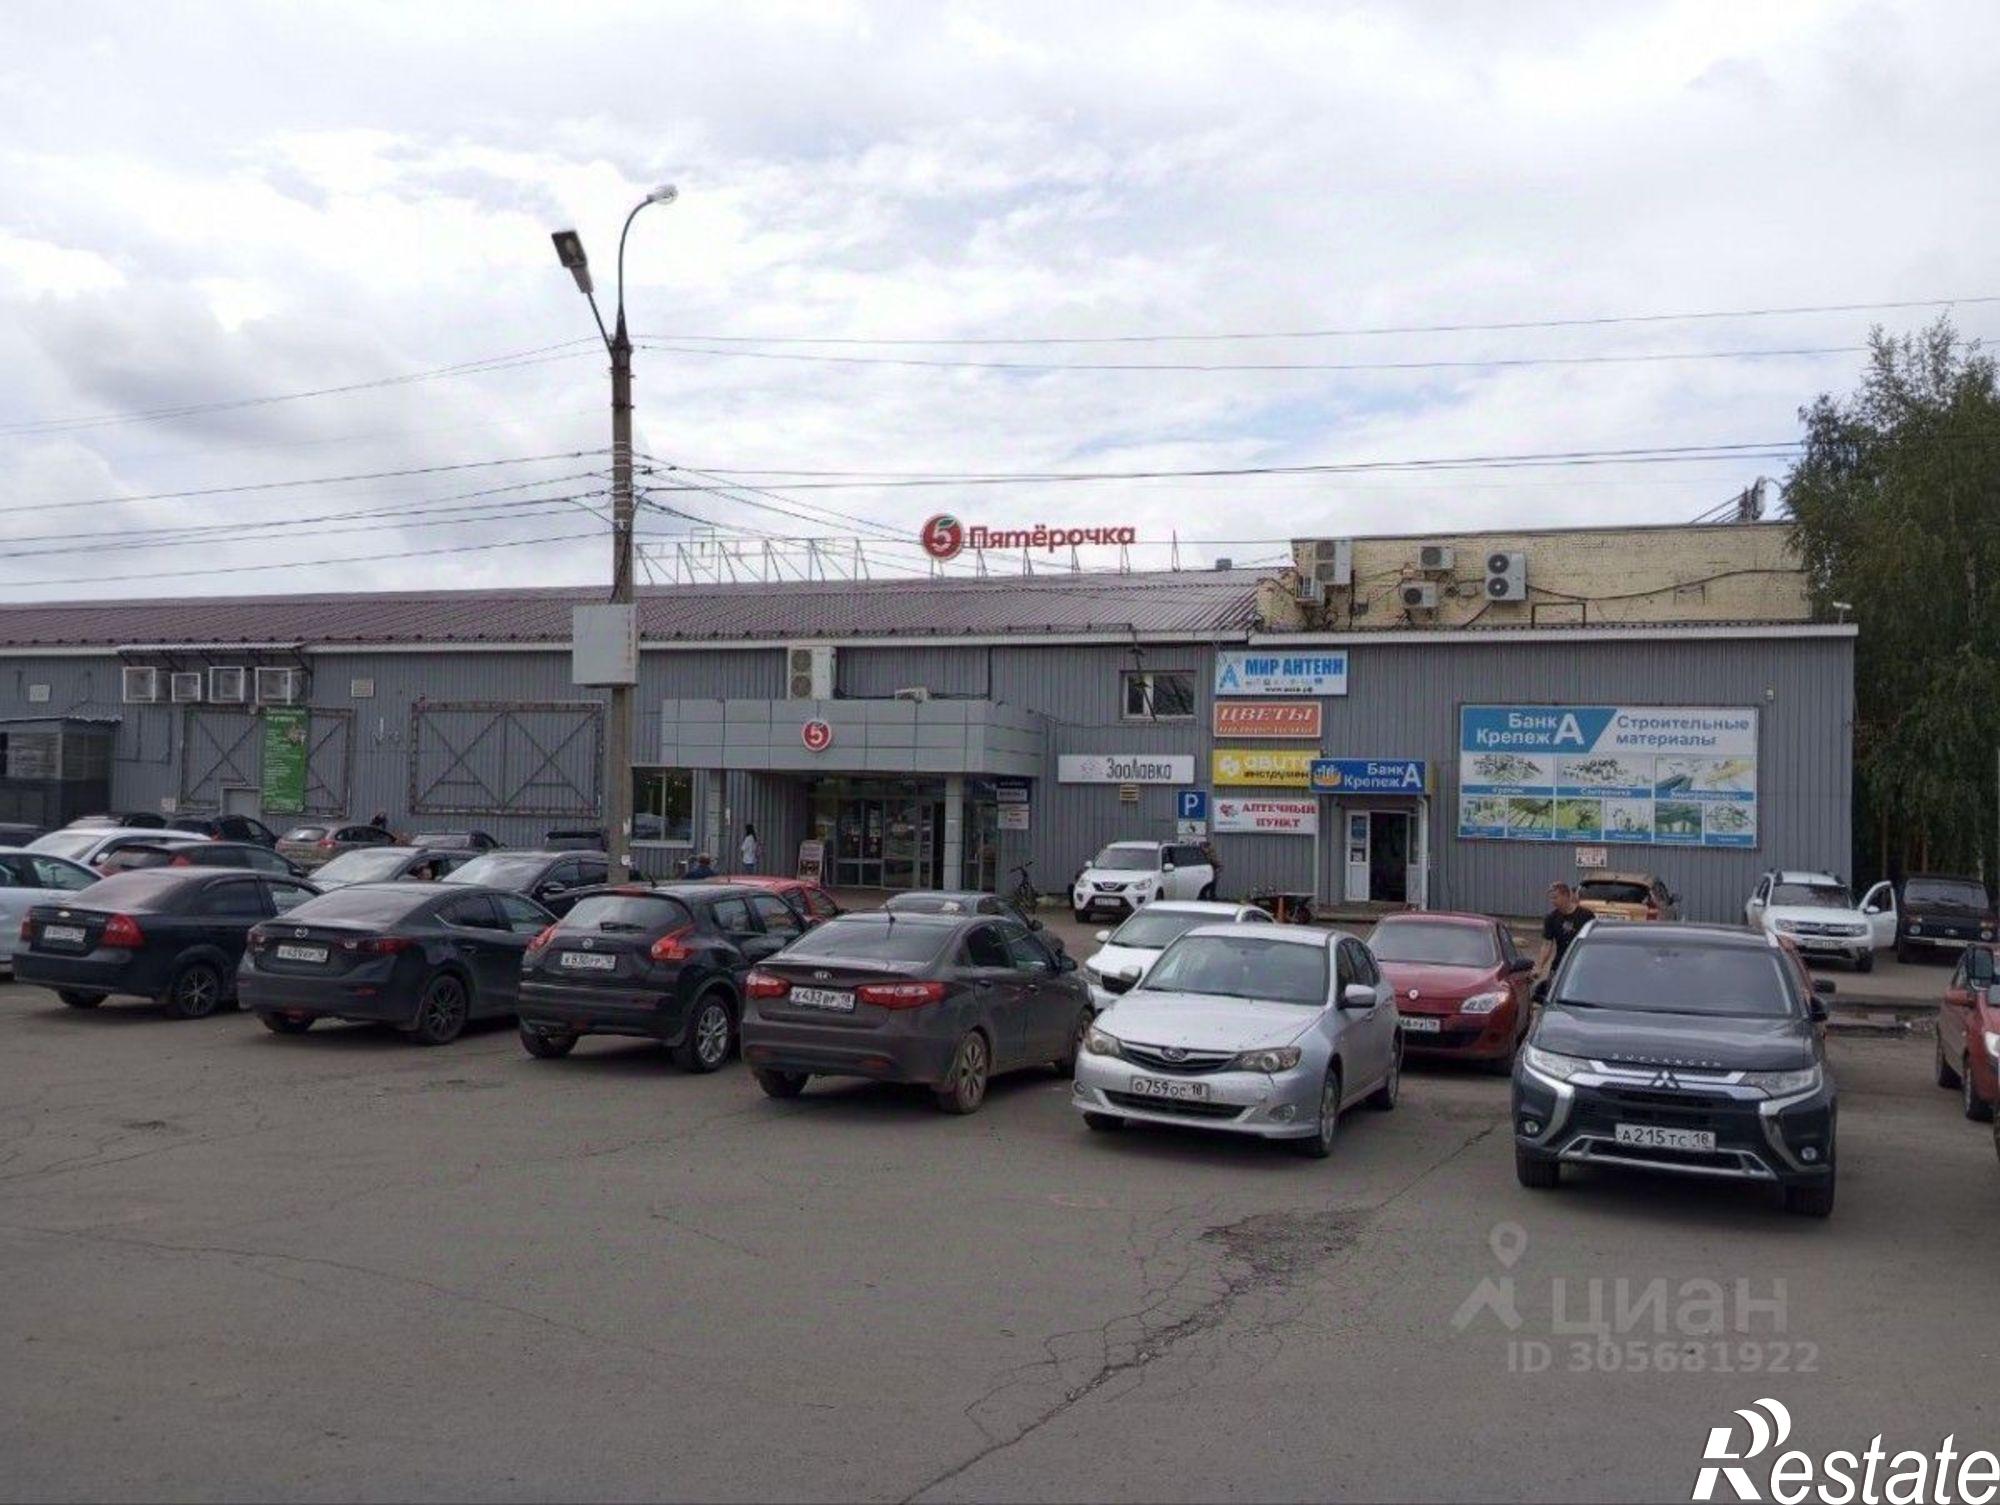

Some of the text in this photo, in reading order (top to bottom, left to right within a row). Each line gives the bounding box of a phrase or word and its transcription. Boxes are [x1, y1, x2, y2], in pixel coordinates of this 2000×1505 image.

[969, 524, 1136, 553] Пятёрочка
[1245, 658, 1343, 676] МИР АНТЕНН
[1220, 707, 1313, 721] ЦВЕТЫ
[1508, 712, 1558, 728] Банк
[1616, 715, 1749, 731] Строительные
[1476, 728, 1551, 747] Крепеж
[1616, 733, 1718, 747] материалы
[1367, 762, 1404, 776] Банк
[1344, 775, 1400, 789] Крепеж
[1184, 793, 1199, 815] P
[1242, 803, 1317, 814] АПТЕЧНЫЙ
[1256, 818, 1300, 828] ПУНКТ
